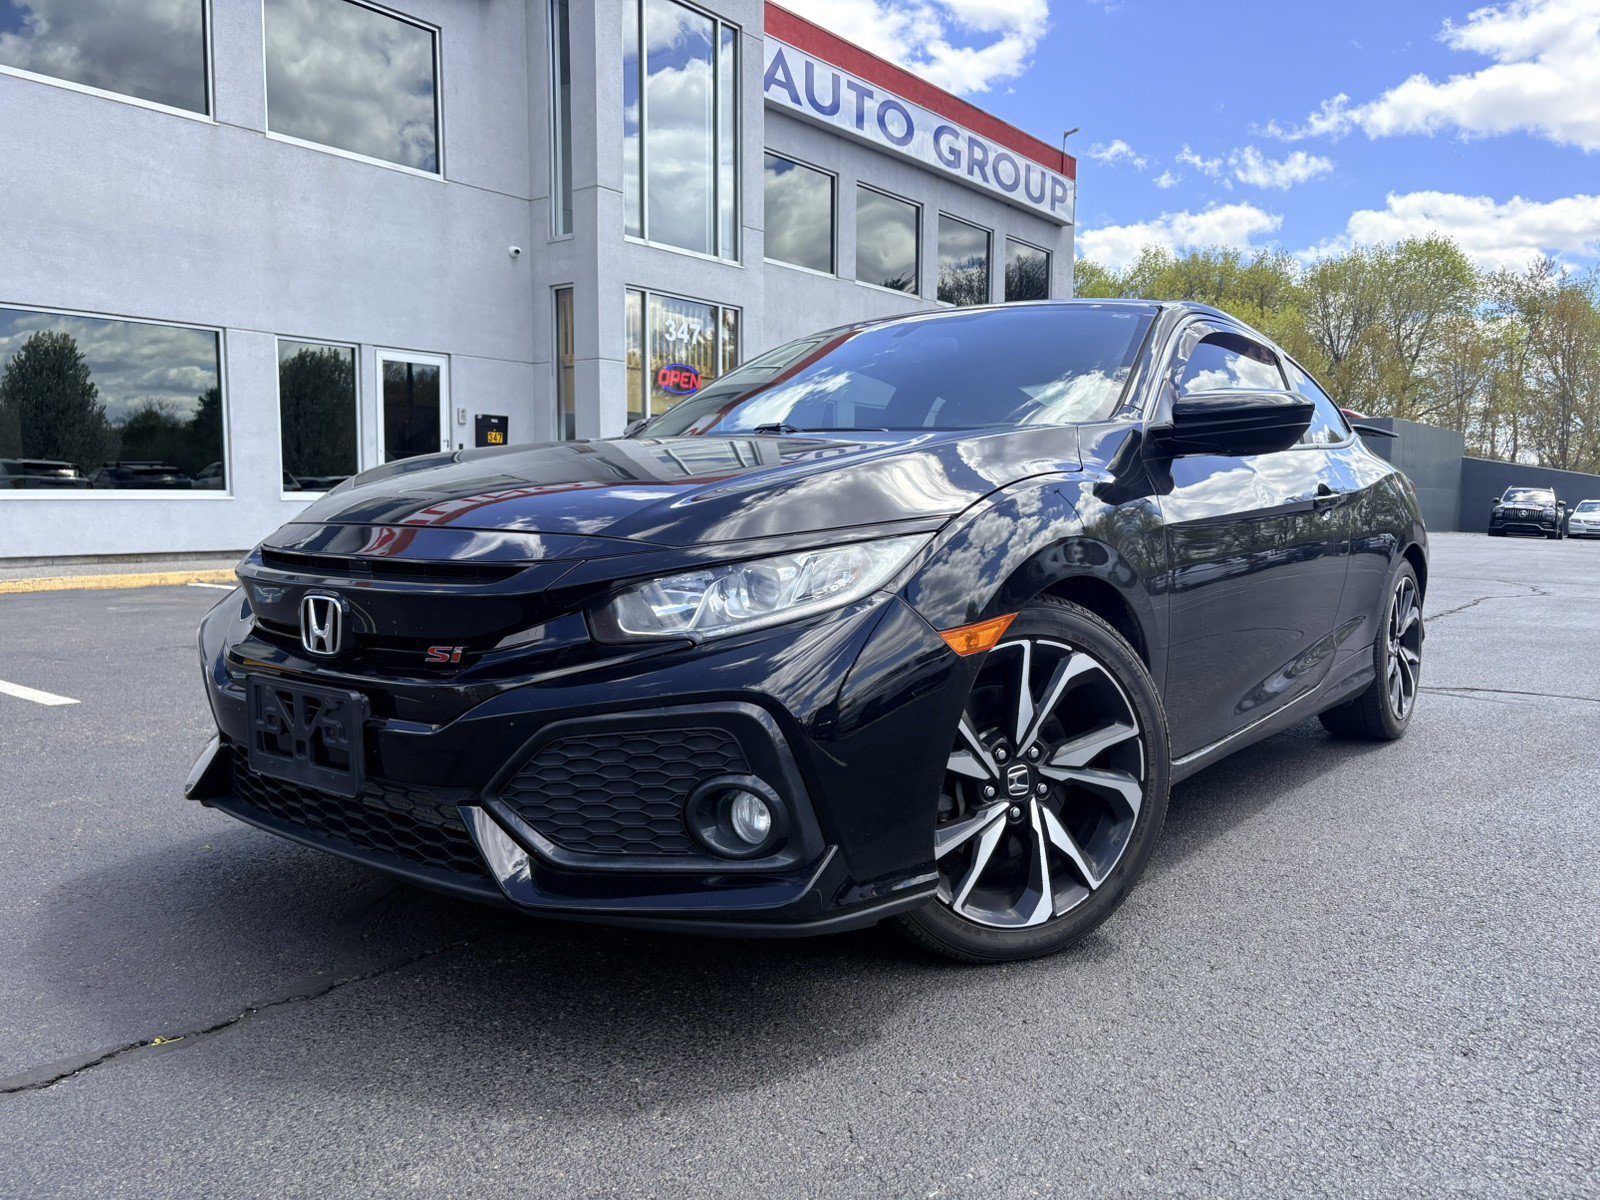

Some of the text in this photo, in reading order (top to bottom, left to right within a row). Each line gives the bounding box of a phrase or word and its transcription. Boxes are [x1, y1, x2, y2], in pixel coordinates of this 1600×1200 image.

[764, 47, 1068, 212] AUTO GROUP
[664, 320, 701, 345] 347
[658, 369, 703, 390] OPEN
[487, 432, 503, 443] 347
